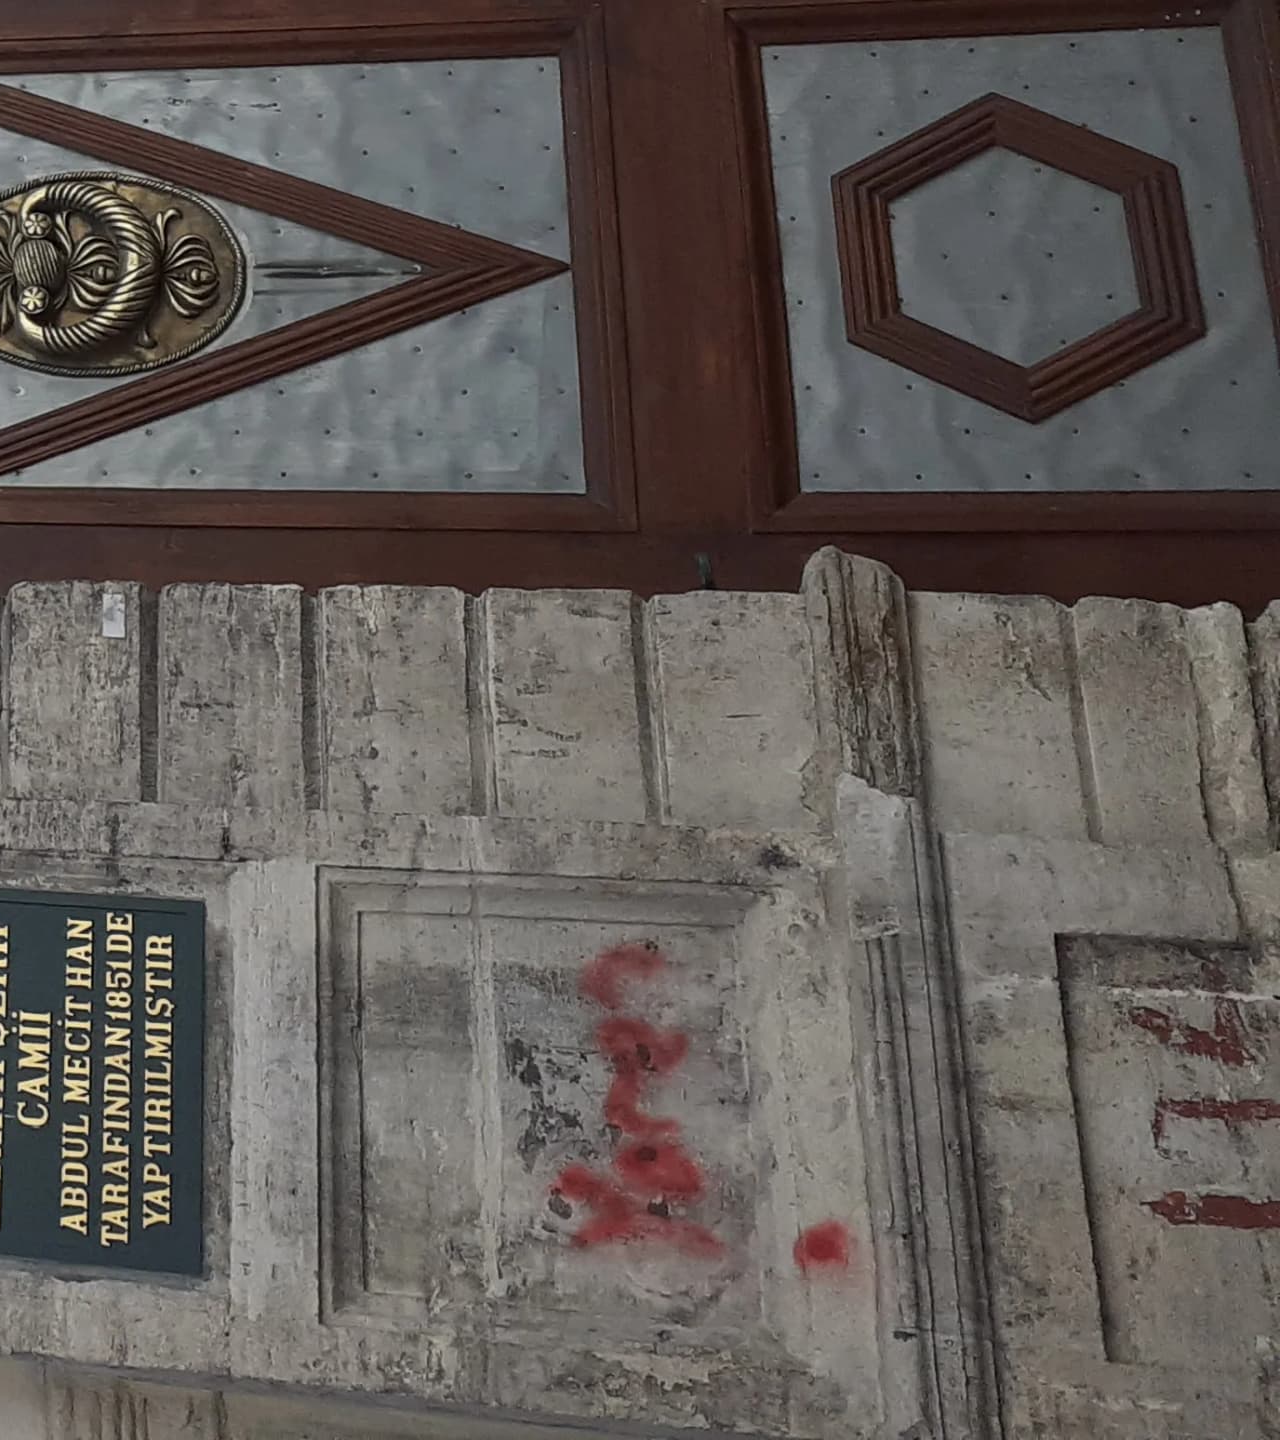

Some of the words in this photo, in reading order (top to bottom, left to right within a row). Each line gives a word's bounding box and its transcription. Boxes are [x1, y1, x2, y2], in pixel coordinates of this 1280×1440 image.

[65, 917, 95, 990] HAN
[105, 912, 134, 955] DE
[104, 957, 134, 1026] 1851
[12, 1010, 52, 1128] CAMİİ
[57, 995, 93, 1104] MECİT
[60, 1114, 90, 1235] ABDUL
[101, 1026, 132, 1247] TARAFINDAN
